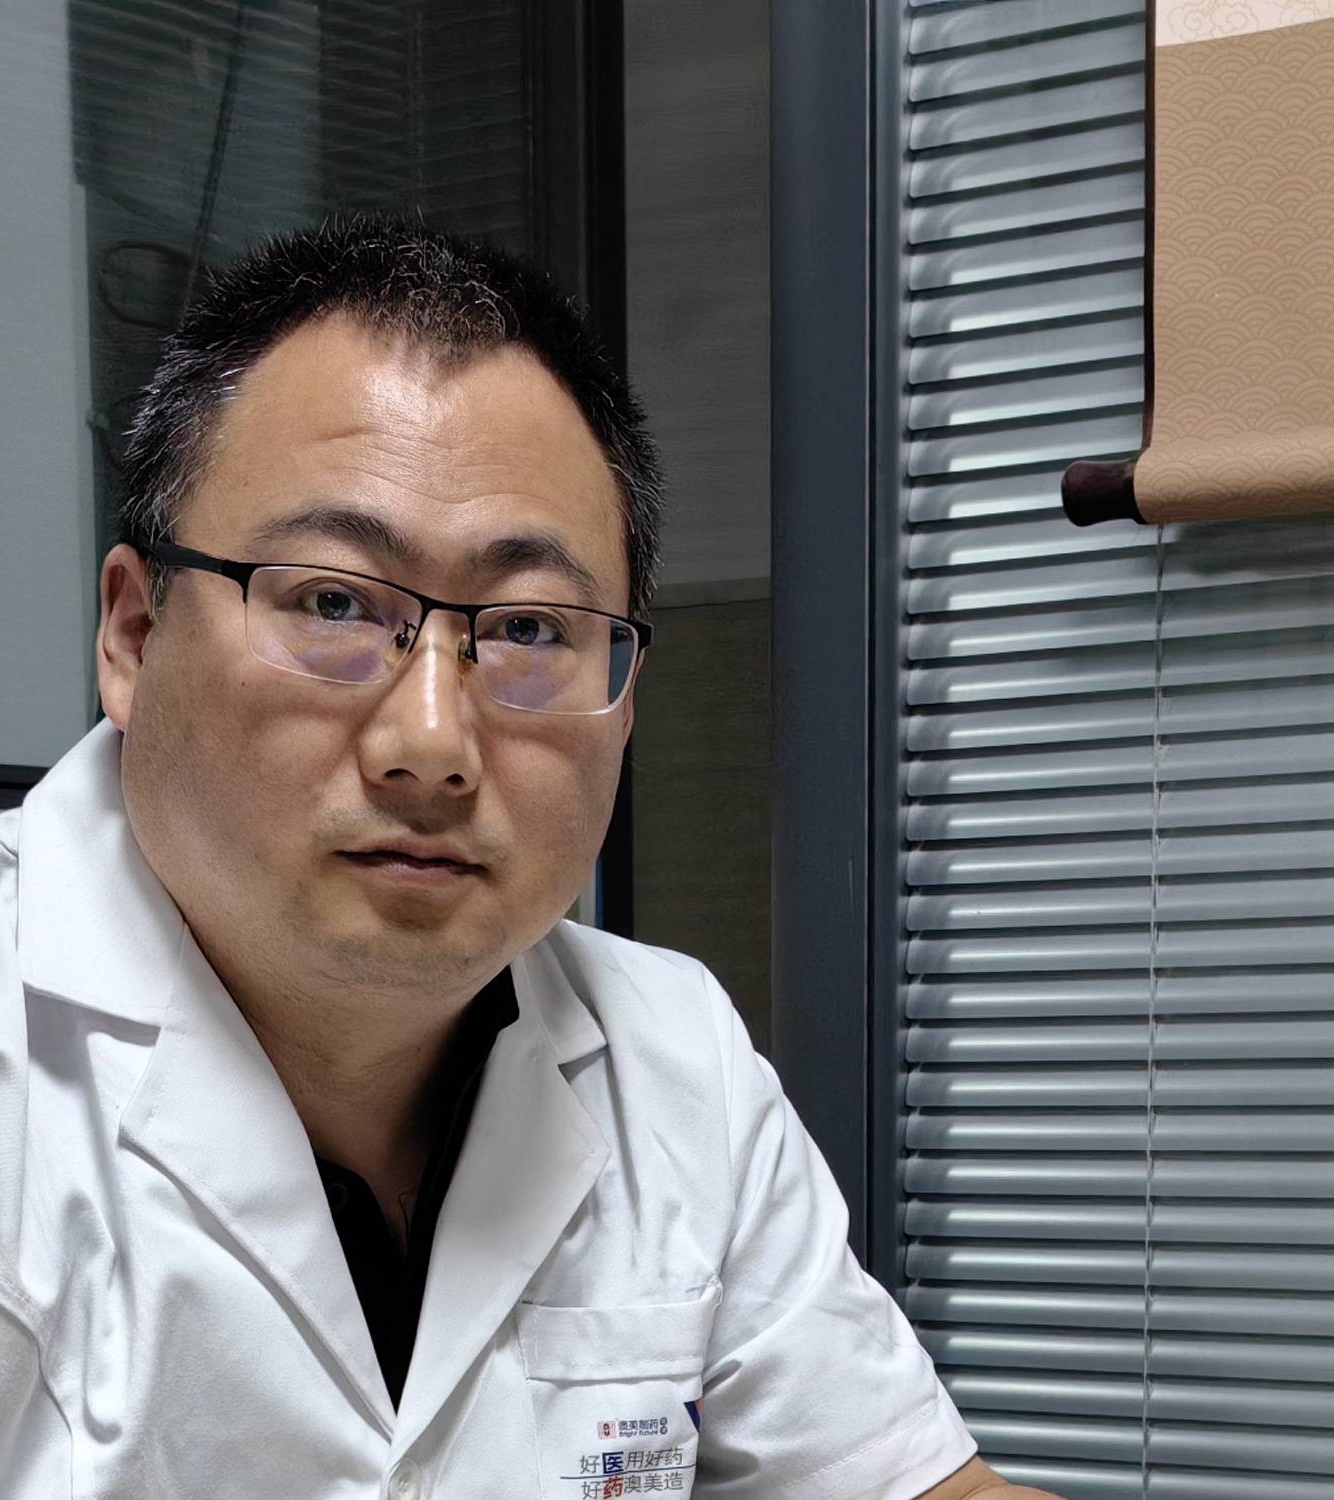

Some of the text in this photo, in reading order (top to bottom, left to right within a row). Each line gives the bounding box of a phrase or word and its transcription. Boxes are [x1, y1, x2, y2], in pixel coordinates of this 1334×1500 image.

[579, 1447, 683, 1475] 好医用好药
[581, 1472, 684, 1500] 好药澳美造
